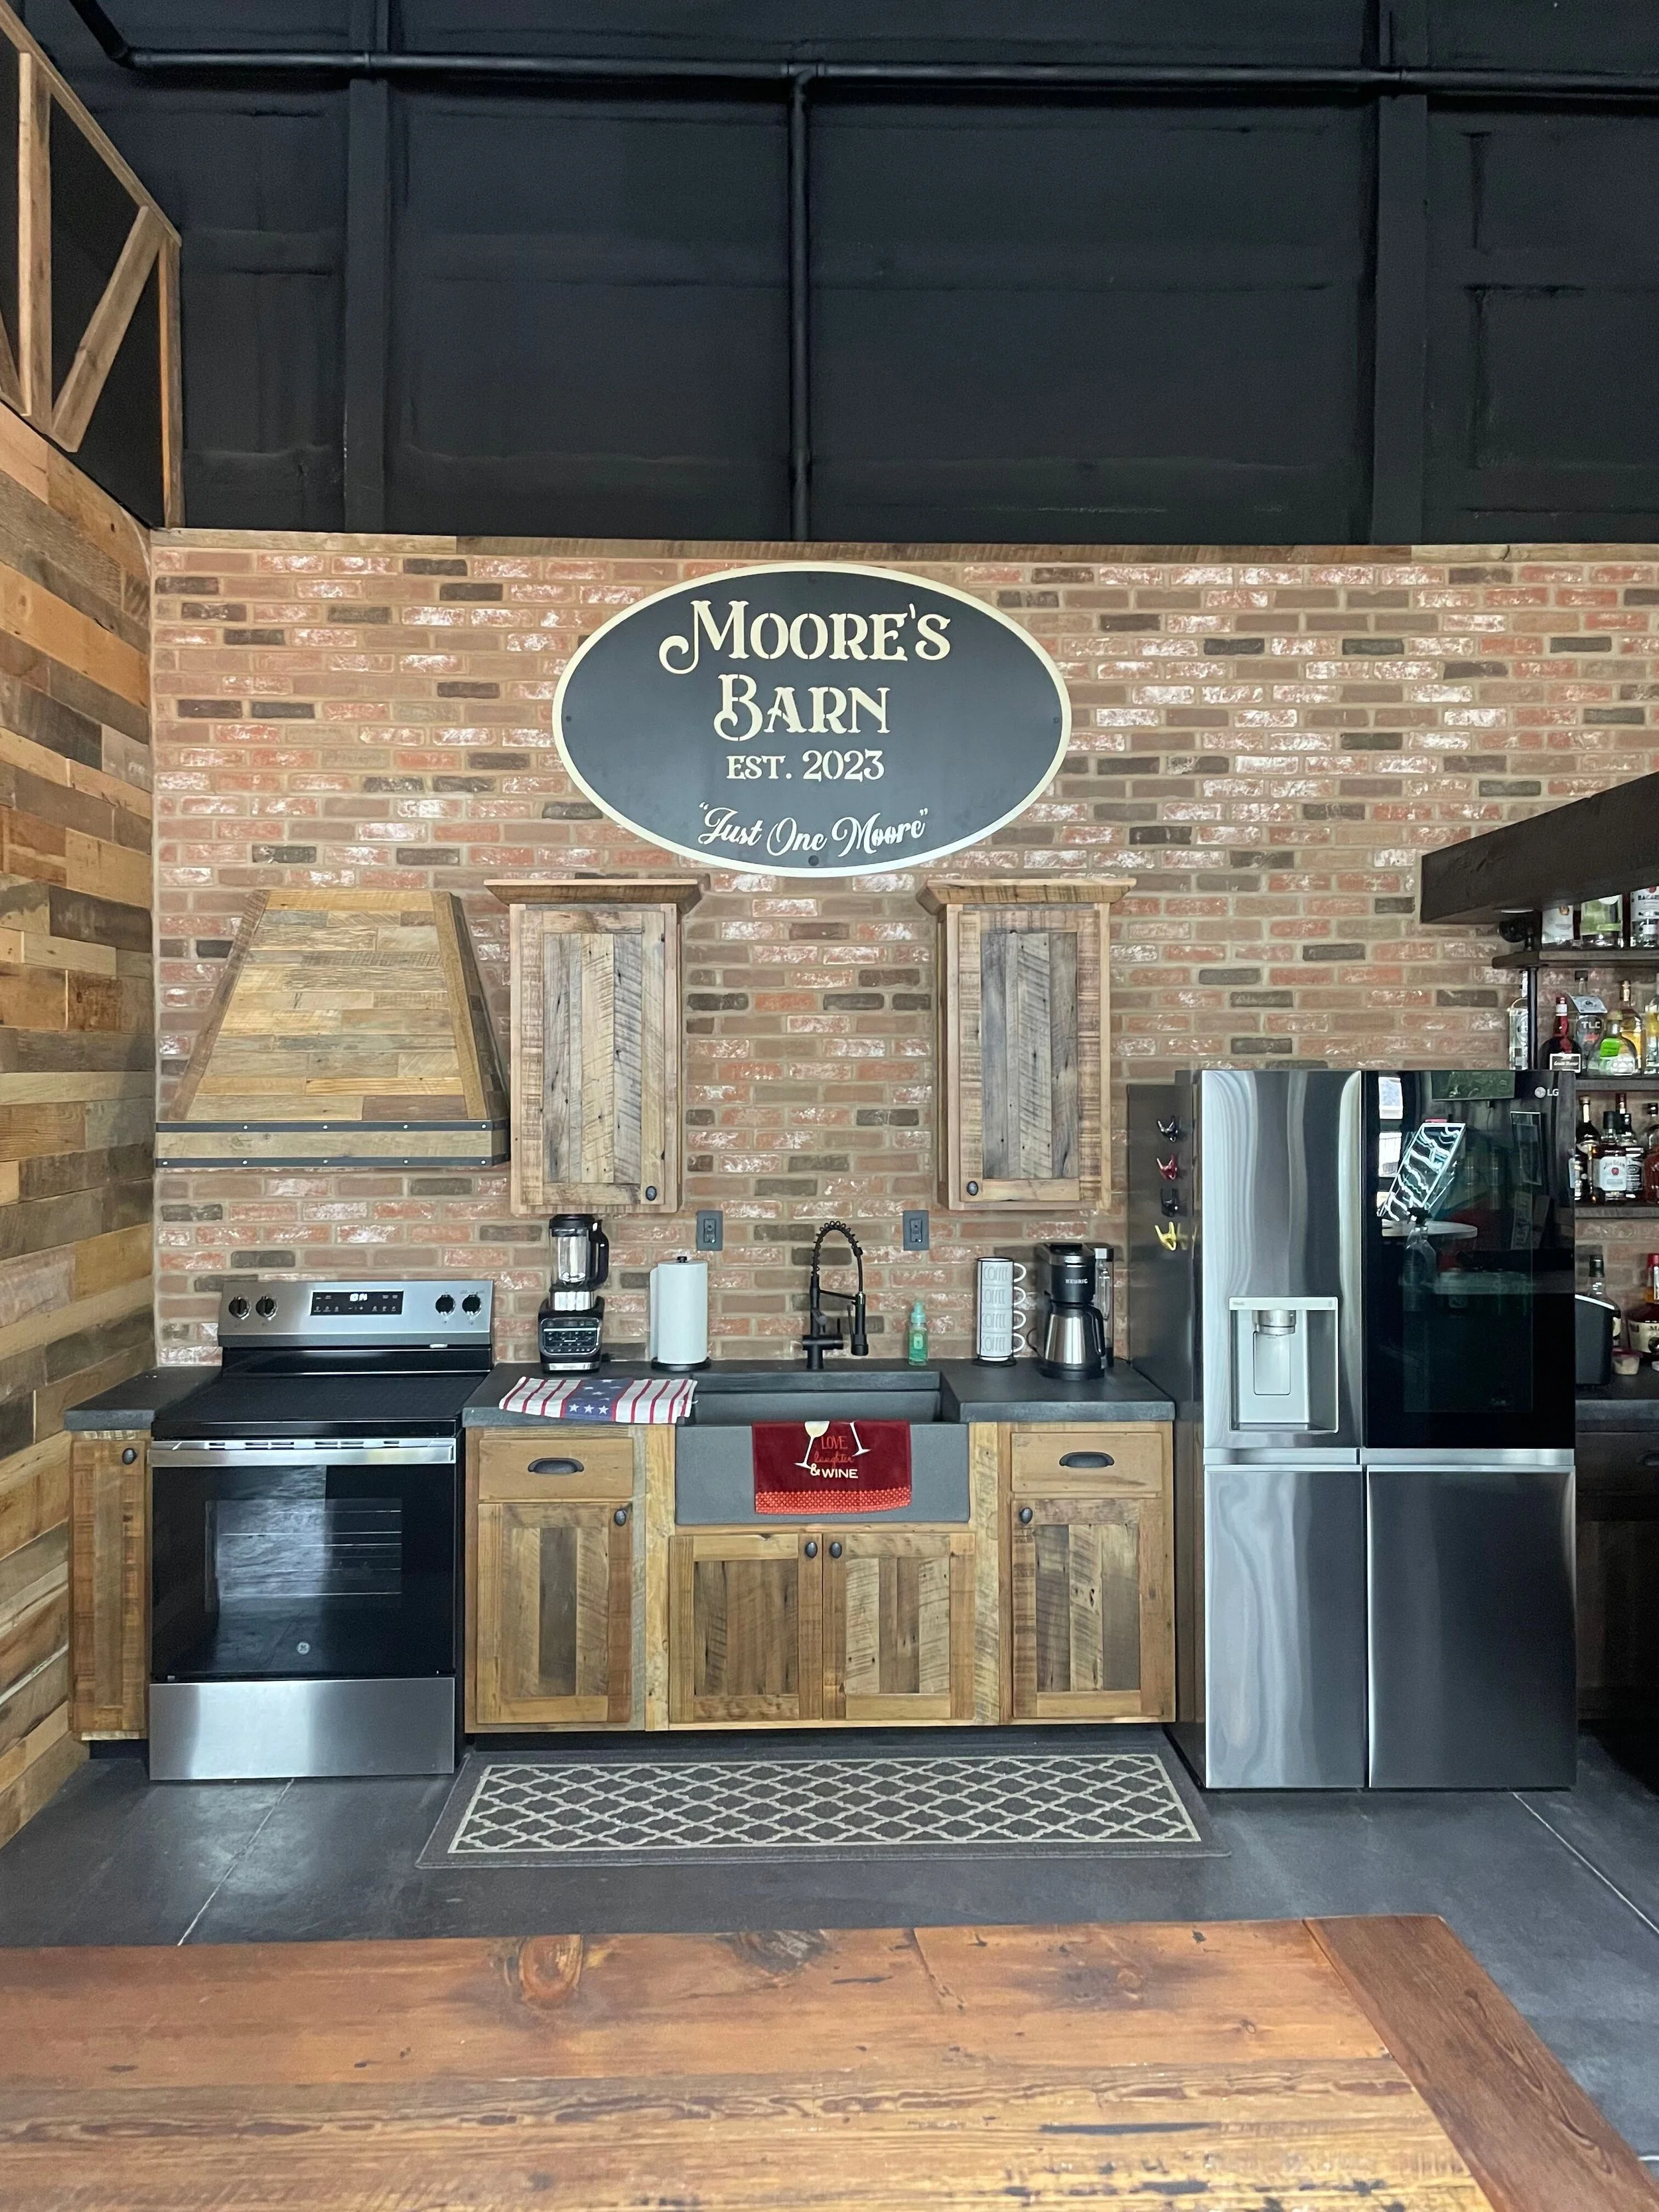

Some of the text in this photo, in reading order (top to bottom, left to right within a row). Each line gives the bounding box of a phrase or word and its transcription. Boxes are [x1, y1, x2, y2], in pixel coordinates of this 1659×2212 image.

[713, 673, 891, 742] BARN
[725, 749, 885, 782] EST. 2023
[766, 816, 828, 856] One
[821, 1436, 848, 1449] LOVE
[814, 1451, 855, 1469] laughter
